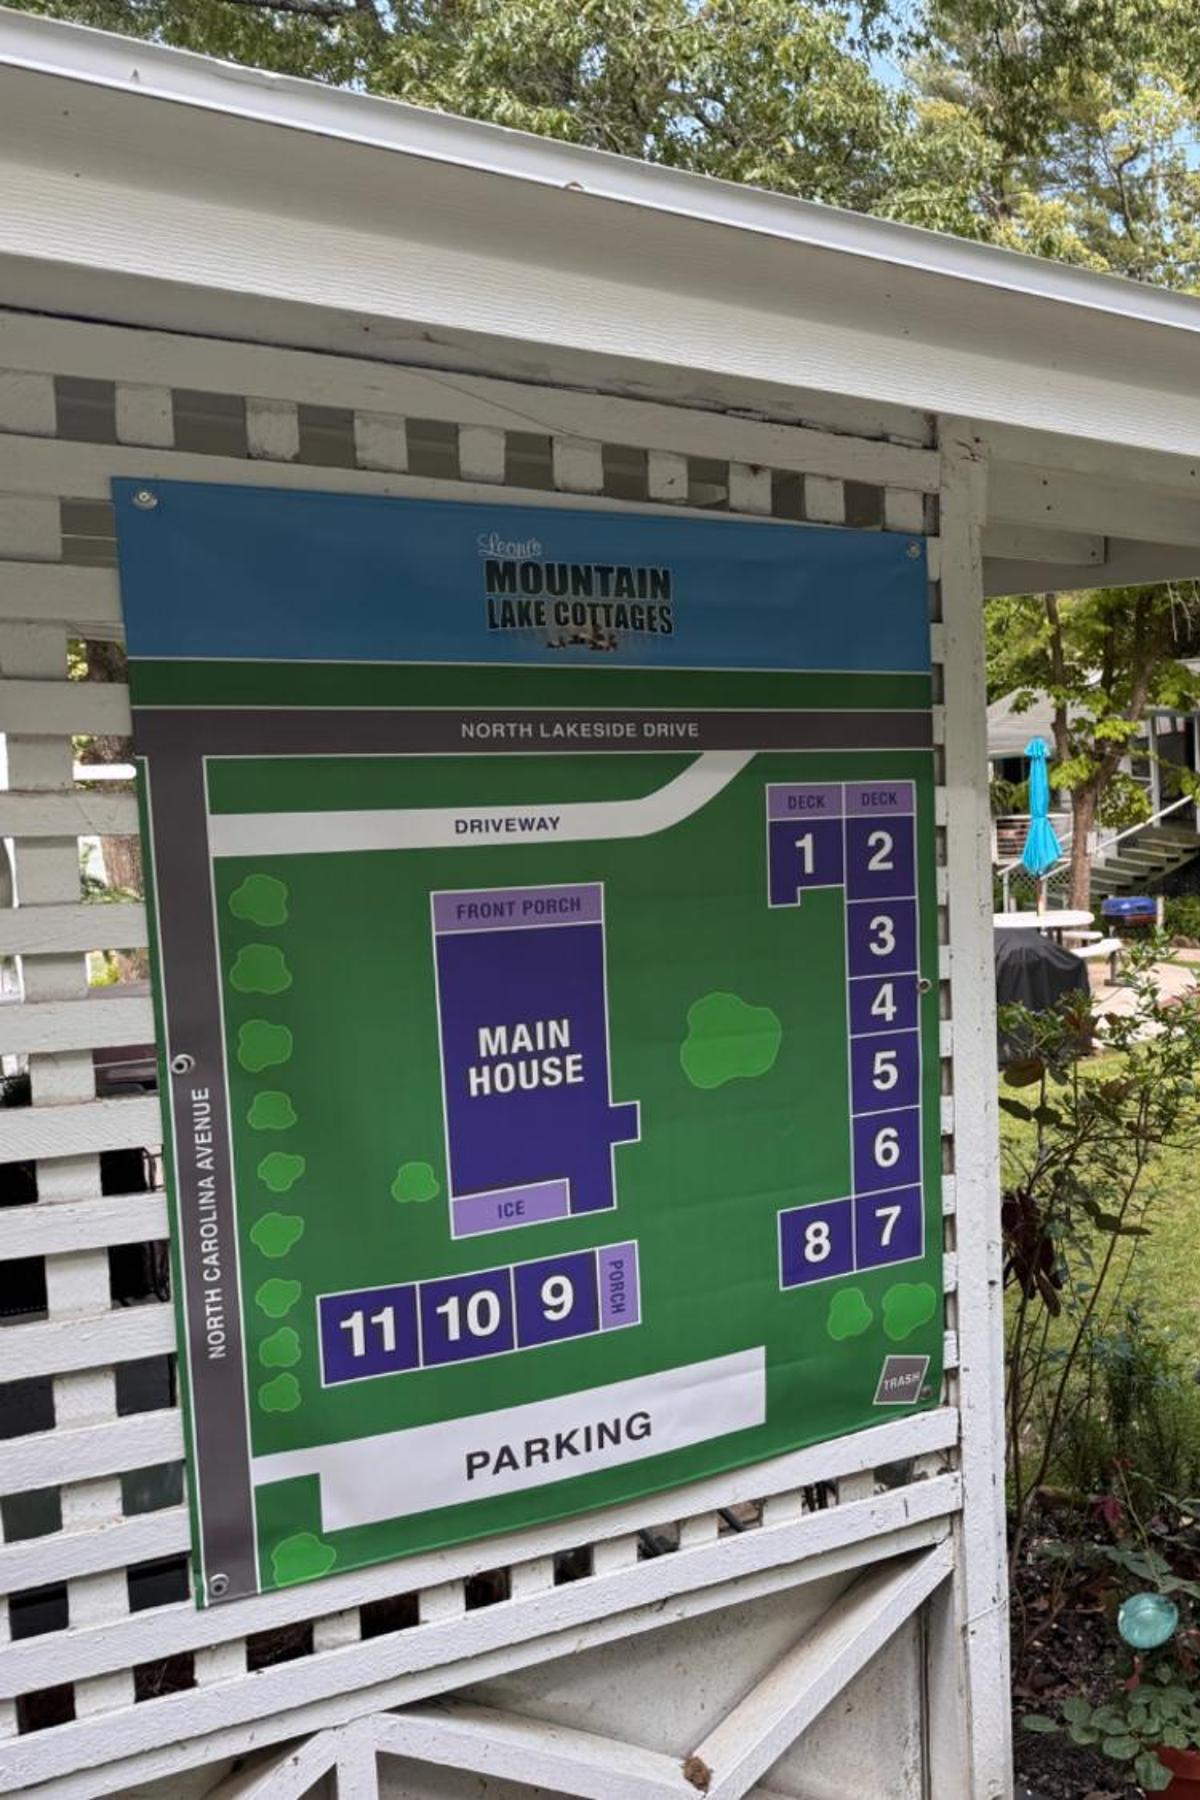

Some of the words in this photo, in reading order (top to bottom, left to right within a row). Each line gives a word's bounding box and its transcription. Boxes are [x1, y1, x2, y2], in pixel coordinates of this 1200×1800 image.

[485, 560, 671, 599] MOUNTAIN
[488, 599, 546, 630] LAKE
[554, 601, 673, 635] COTTAGES
[461, 722, 532, 738] NORTH
[540, 722, 637, 738] LAKESIDE
[643, 722, 699, 738] DRIVE
[787, 794, 825, 810] DECK
[861, 791, 898, 806] DECK
[454, 816, 561, 834] DRIVEWAY
[795, 832, 814, 875] 1
[867, 830, 894, 871] 2
[456, 901, 516, 920] FRONT
[522, 897, 582, 916] PORCH
[869, 915, 896, 956] 3
[870, 982, 898, 1022] 4
[478, 1018, 570, 1058] MAIN
[468, 1053, 585, 1097] HOUSE
[872, 1050, 898, 1091] 5
[191, 1088, 215, 1171] AVENUE
[873, 1127, 900, 1168] 6
[198, 1175, 222, 1284] CAROLINA
[497, 1201, 525, 1219] ICE
[874, 1205, 901, 1247] 7
[803, 1220, 832, 1263] 8
[540, 1274, 575, 1322] 9
[608, 1259, 627, 1315] PORCH
[205, 1288, 227, 1361] NORTH
[339, 1306, 396, 1358] 11
[435, 1289, 501, 1341] 10
[465, 1410, 652, 1481] PARKING
